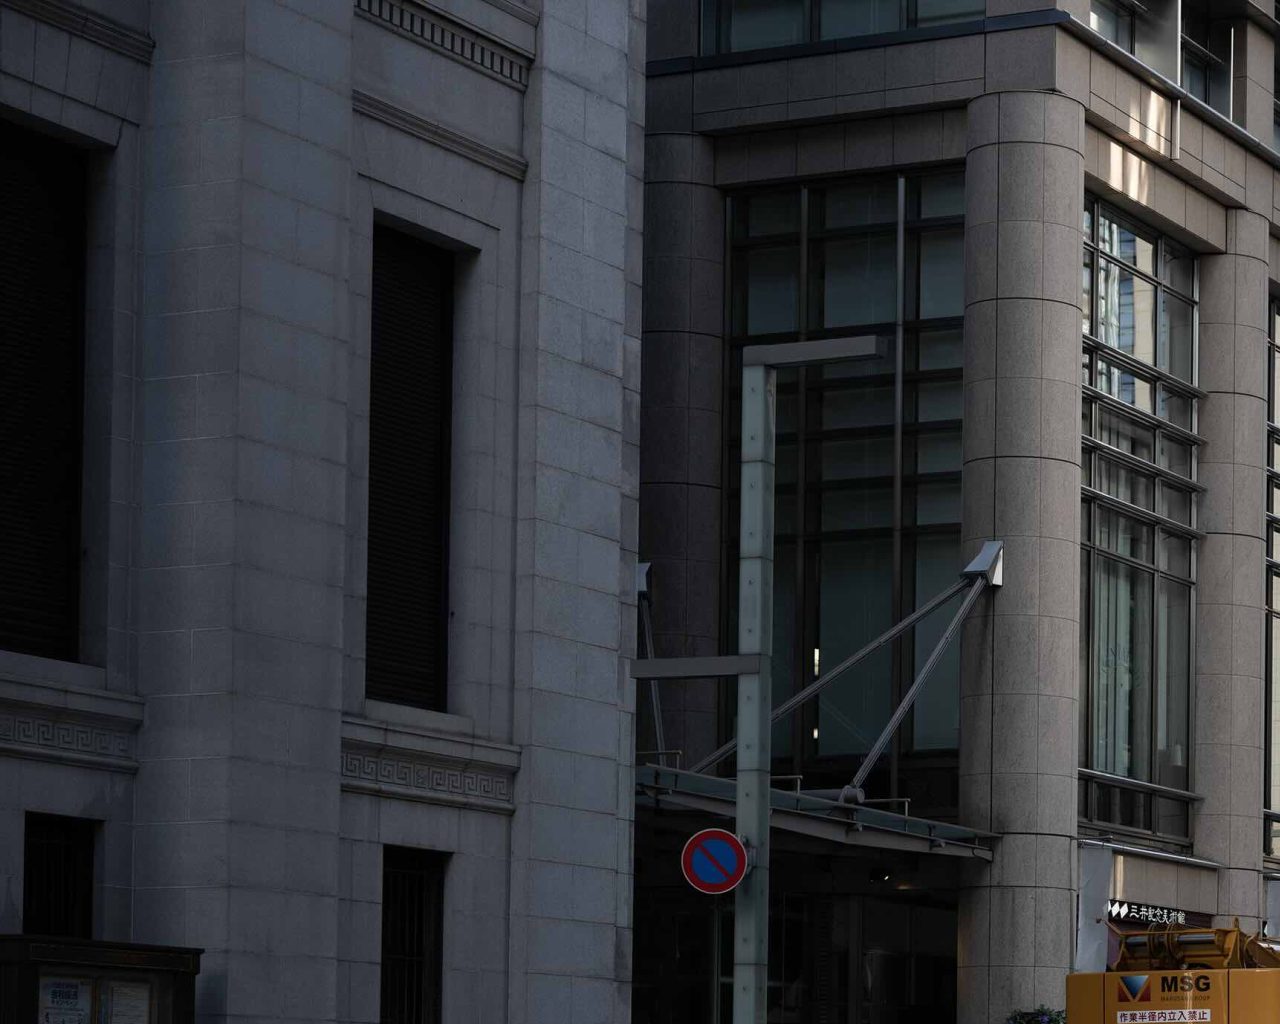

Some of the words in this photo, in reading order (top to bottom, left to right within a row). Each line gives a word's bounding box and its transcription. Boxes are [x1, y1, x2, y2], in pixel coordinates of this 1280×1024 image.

[1129, 904, 1186, 925] 三井記念美術館
[1161, 975, 1211, 993] MSG
